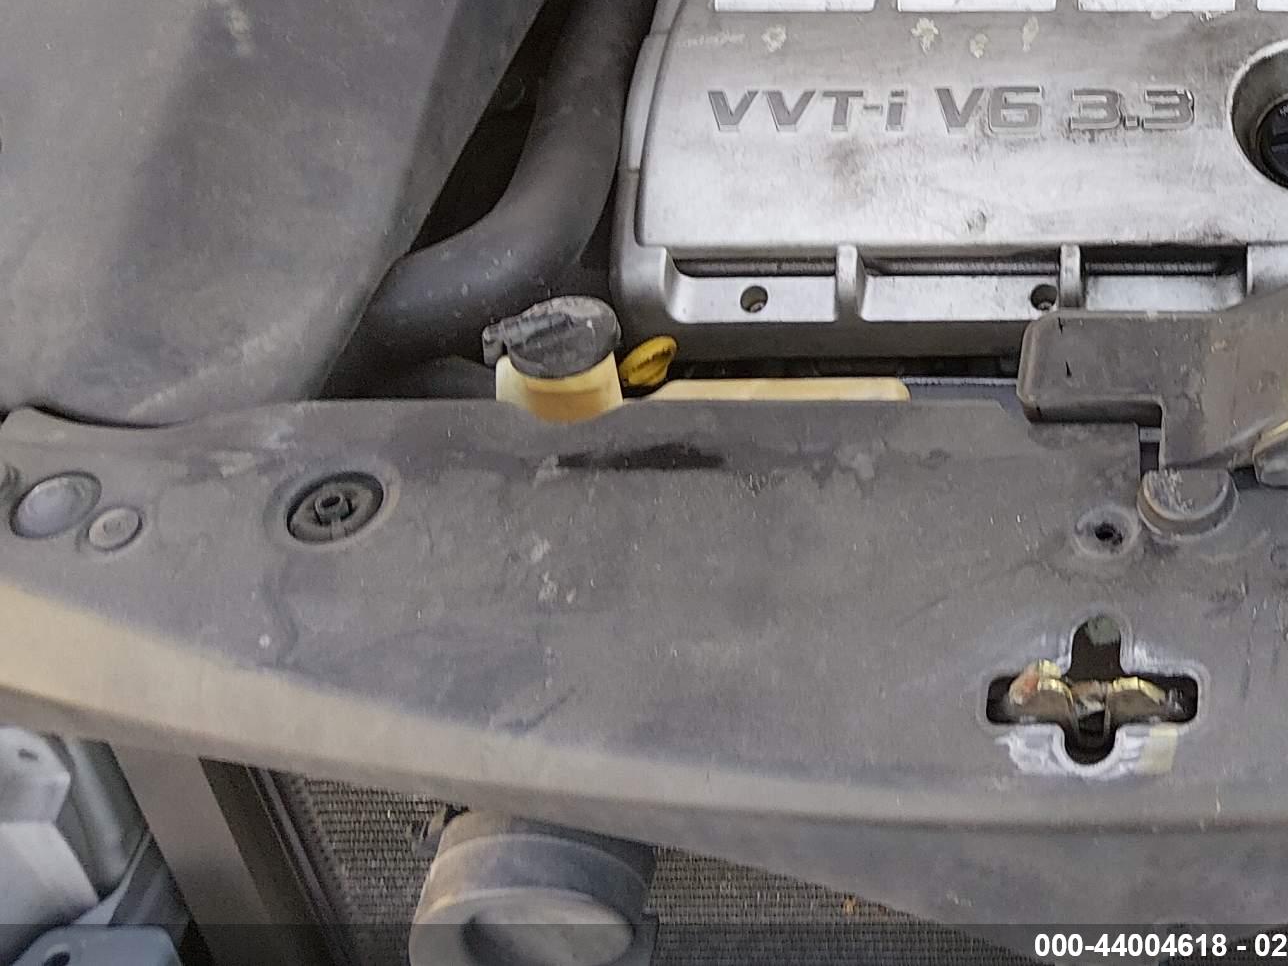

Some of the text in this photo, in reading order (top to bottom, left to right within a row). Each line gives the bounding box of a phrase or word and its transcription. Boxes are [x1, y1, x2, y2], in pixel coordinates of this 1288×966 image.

[707, 85, 1195, 134] VVT-i V6 3.3
